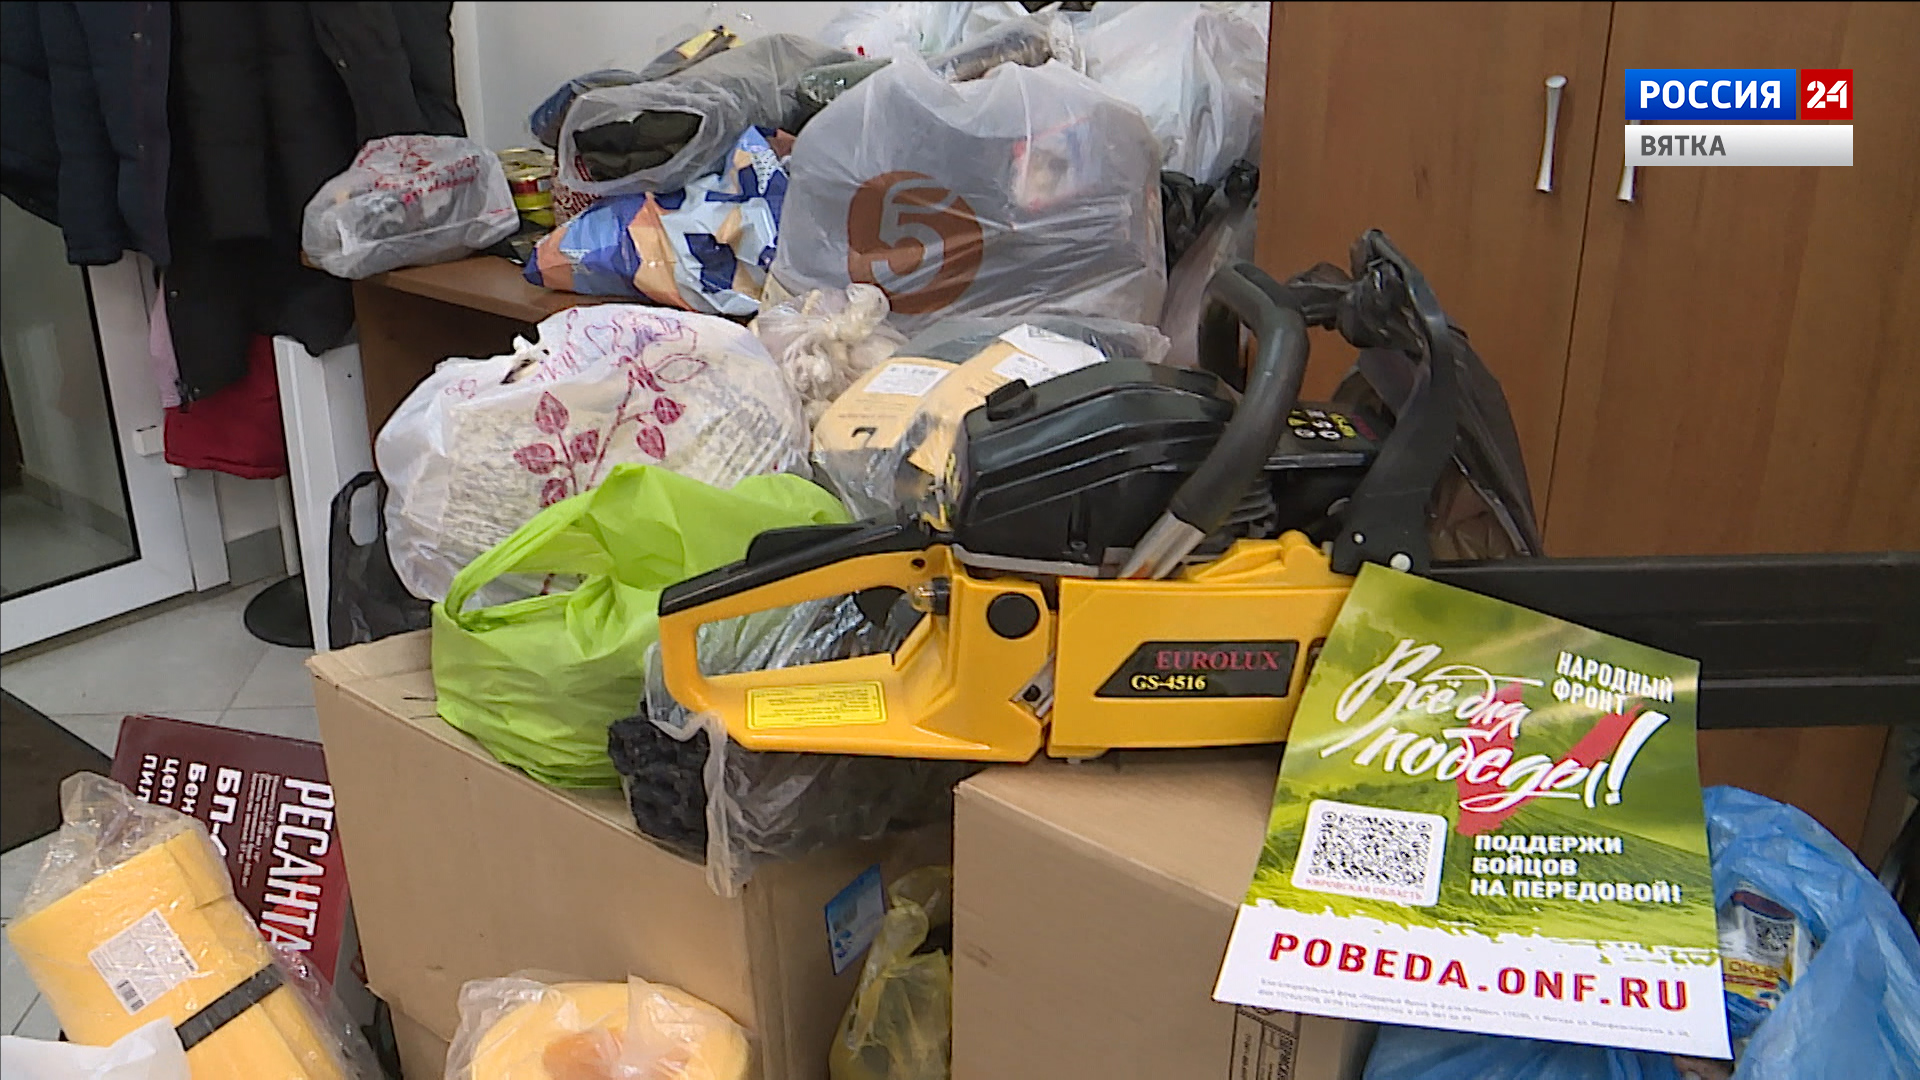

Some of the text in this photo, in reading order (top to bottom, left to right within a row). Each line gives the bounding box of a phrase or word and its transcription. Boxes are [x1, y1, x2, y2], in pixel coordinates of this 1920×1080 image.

[1131, 674, 1207, 691] GS-4516
[1156, 650, 1279, 671] EUROLUX
[1555, 651, 1674, 702] НАРОДНЫЙ
[1320, 638, 1462, 758] Всё
[1552, 677, 1628, 716] ФРОНТ
[137, 754, 158, 803] пил
[158, 758, 181, 804] цеп
[1354, 711, 1669, 813] победы!
[181, 763, 208, 814] Бен
[259, 777, 335, 950] РЕСАНТА
[1472, 854, 1578, 877] БОЙЦОВ
[1475, 835, 1623, 854] ПОДДЕРЖИ
[1470, 880, 1682, 903] НА ПЕРЕДОВОЙ!
[1269, 932, 1688, 1011] POBEDA.ONF.RU
